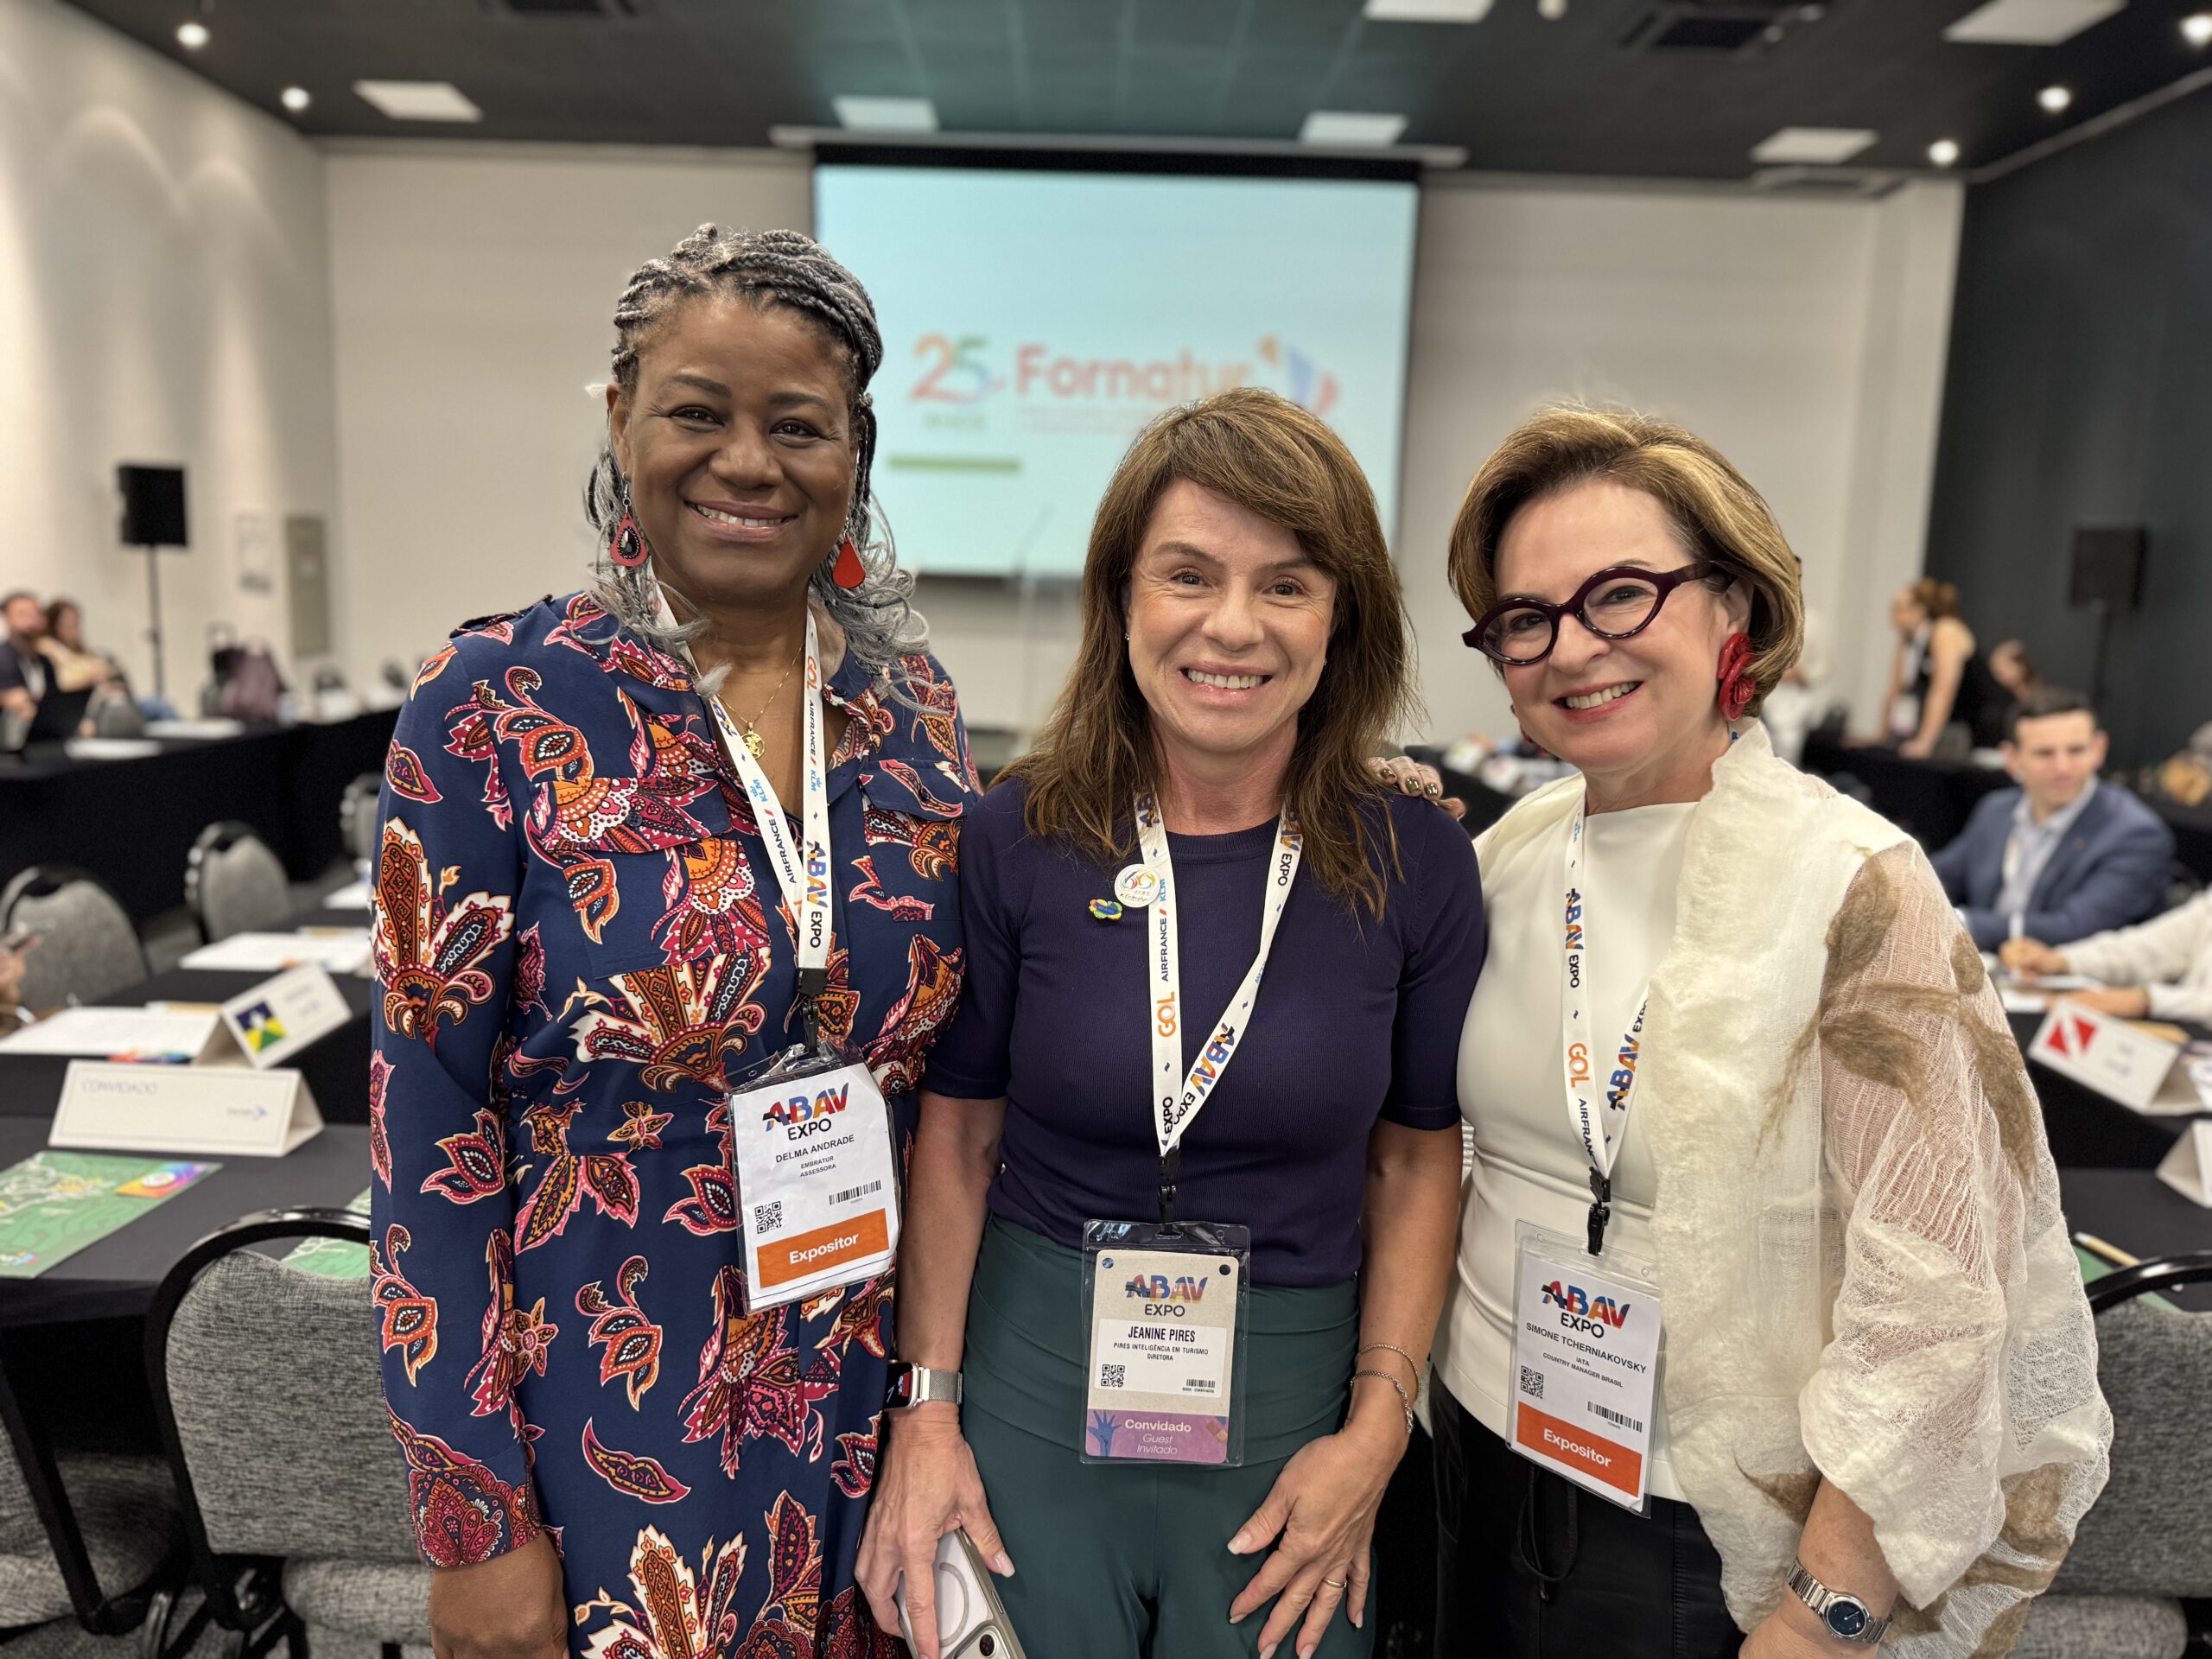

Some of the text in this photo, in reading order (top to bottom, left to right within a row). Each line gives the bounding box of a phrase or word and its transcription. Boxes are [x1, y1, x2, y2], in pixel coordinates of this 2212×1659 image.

[910, 334, 1255, 404] 25 Fornatur
[805, 655, 818, 690] GOL
[806, 699, 816, 757] AIRFRANCE
[753, 779, 767, 803] KLM
[809, 770, 817, 792] KLM
[768, 818, 798, 884] AIRFRANCE
[1277, 853, 1293, 887] EXPO
[806, 841, 829, 949] ABAV EXPO
[1565, 888, 1584, 988] ABAV EXPO
[1157, 991, 1176, 1038] GOL
[1190, 1023, 1235, 1097] ABAV
[1568, 1042, 1590, 1089] GOL
[1607, 1033, 1640, 1111] ABAV
[762, 1082, 849, 1133] ABAV
[1163, 1096, 1173, 1134] EXPO
[787, 1118, 832, 1141] EXPO
[775, 1135, 855, 1163] DELMA ANDRADE
[801, 1156, 834, 1169] EMBRATUR
[800, 1163, 836, 1177] ASSESSORA
[789, 1232, 859, 1265] Expositor
[1125, 1274, 1208, 1304] ABAV
[1541, 1281, 1630, 1329] ABAV
[1144, 1303, 1185, 1318] EXPO
[1560, 1312, 1605, 1338] EXPO
[1128, 1325, 1196, 1343] JEANINE PIRES
[1132, 1344, 1171, 1352] INTELIGÊNCIA
[1526, 1322, 1647, 1374] SIMONE TCHERNIAKOVSKY
[1542, 1352, 1624, 1388] COUNTRY MANAGER BRASIL
[1576, 1357, 1590, 1367] IATA
[1125, 1420, 1192, 1433] Convidado
[1142, 1433, 1173, 1444] Guest
[1137, 1444, 1178, 1455] Invitado
[1543, 1427, 1611, 1468] Expositor
